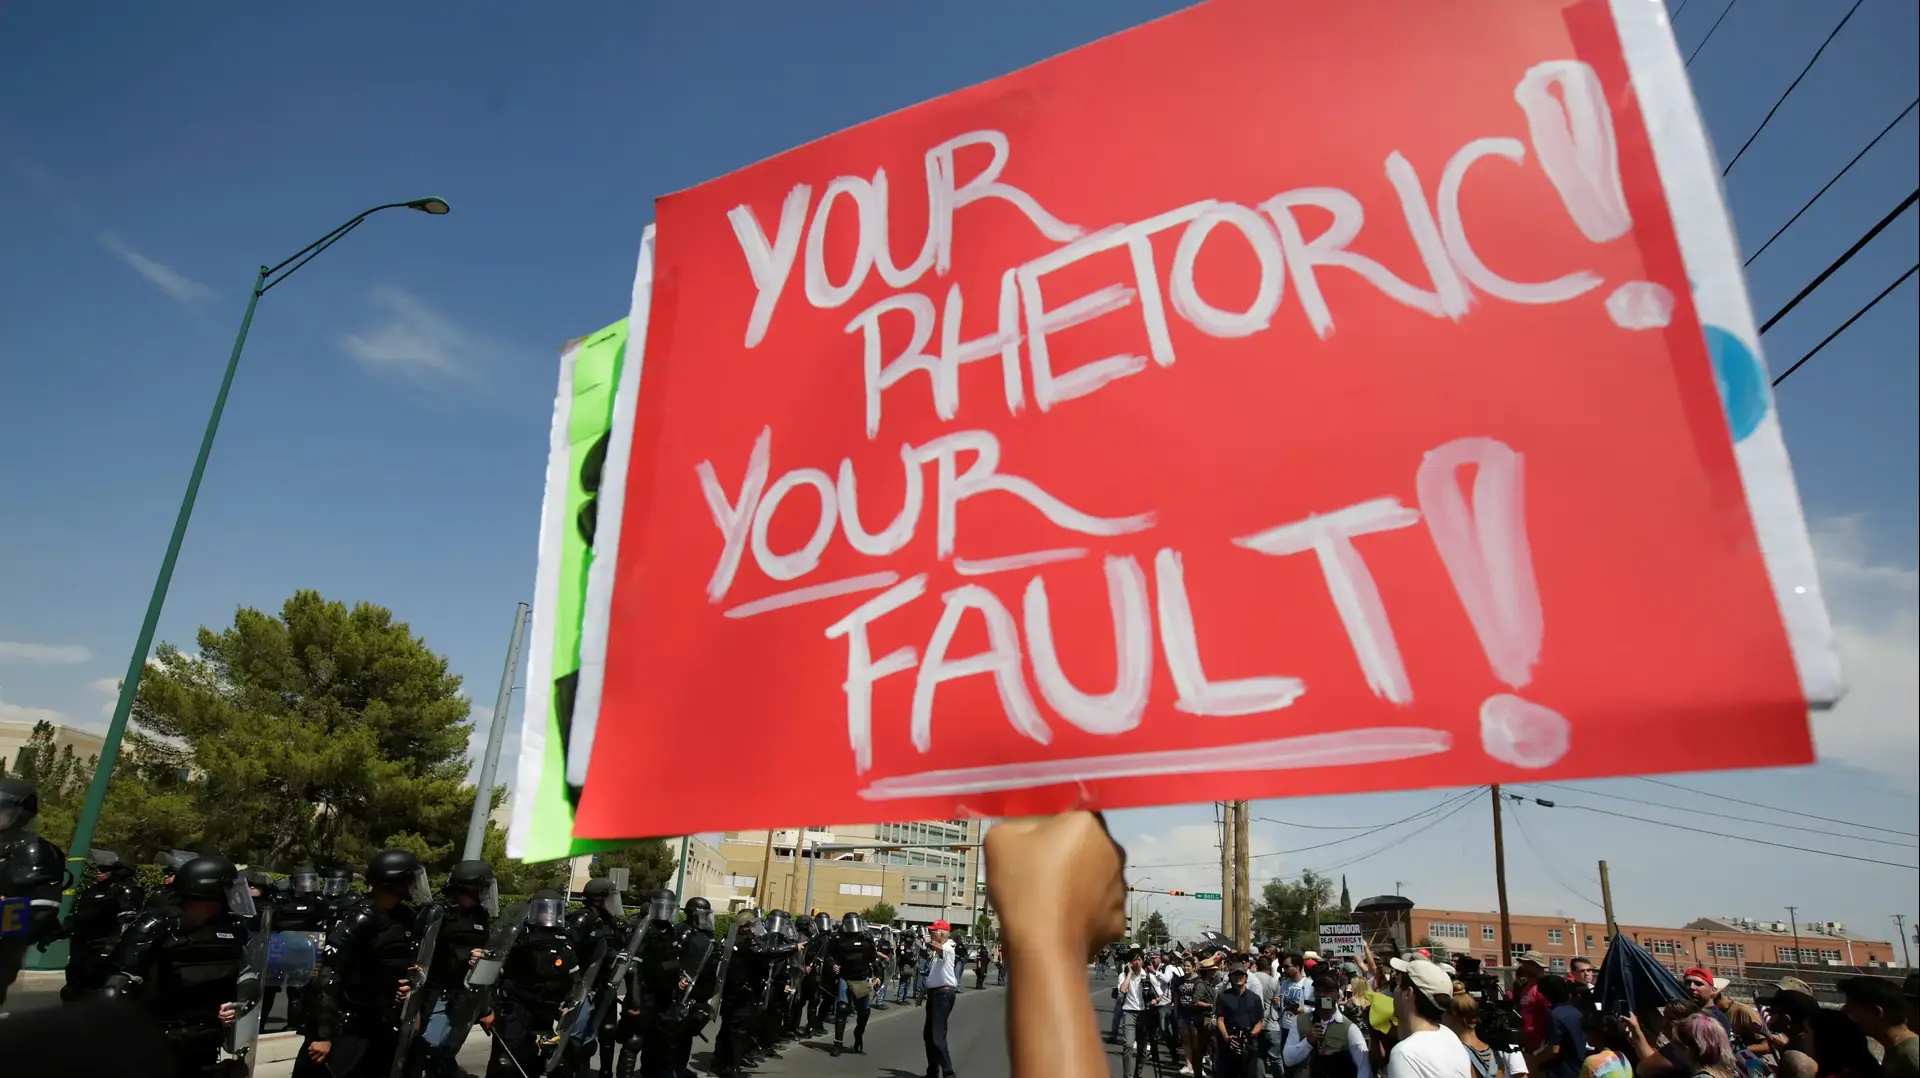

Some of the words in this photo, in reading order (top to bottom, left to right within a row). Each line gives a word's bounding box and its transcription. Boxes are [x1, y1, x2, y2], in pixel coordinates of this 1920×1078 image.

[727, 130, 1088, 349] YOUR
[844, 59, 1675, 440] RHETORIC!
[695, 425, 1158, 604] YOUR
[824, 436, 1572, 777] FAULT!
[1320, 923, 1361, 936] INSTIGADOR
[1334, 936, 1358, 944] AMERICA
